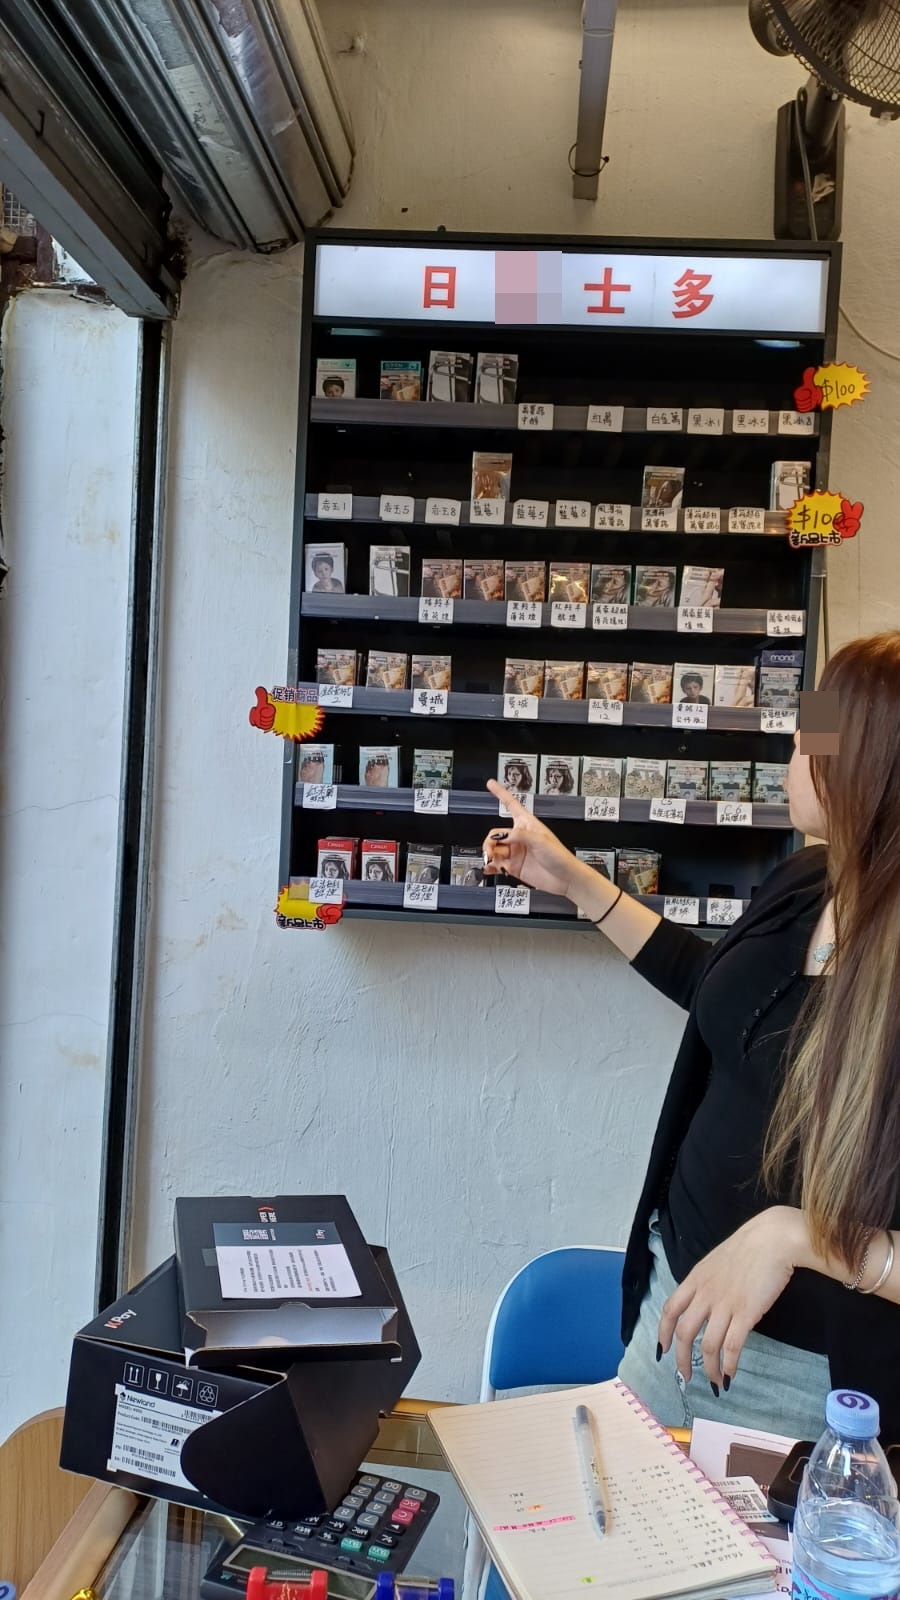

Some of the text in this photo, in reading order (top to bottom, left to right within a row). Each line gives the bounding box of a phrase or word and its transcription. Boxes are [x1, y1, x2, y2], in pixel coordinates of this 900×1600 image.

[823, 379, 856, 402] $100
[791, 529, 841, 546] 新品上市
[272, 686, 318, 703] 促销商品
[418, 692, 444, 707] 曼城
[429, 706, 436, 714] 5
[599, 713, 610, 721] 12
[278, 917, 325, 930] 新品上市
[103, 1309, 137, 1329] KPay
[126, 1395, 156, 1408] Newland
[385, 1481, 400, 1490] 00
[341, 1508, 350, 1516] 8
[351, 1526, 369, 1536] MRC
